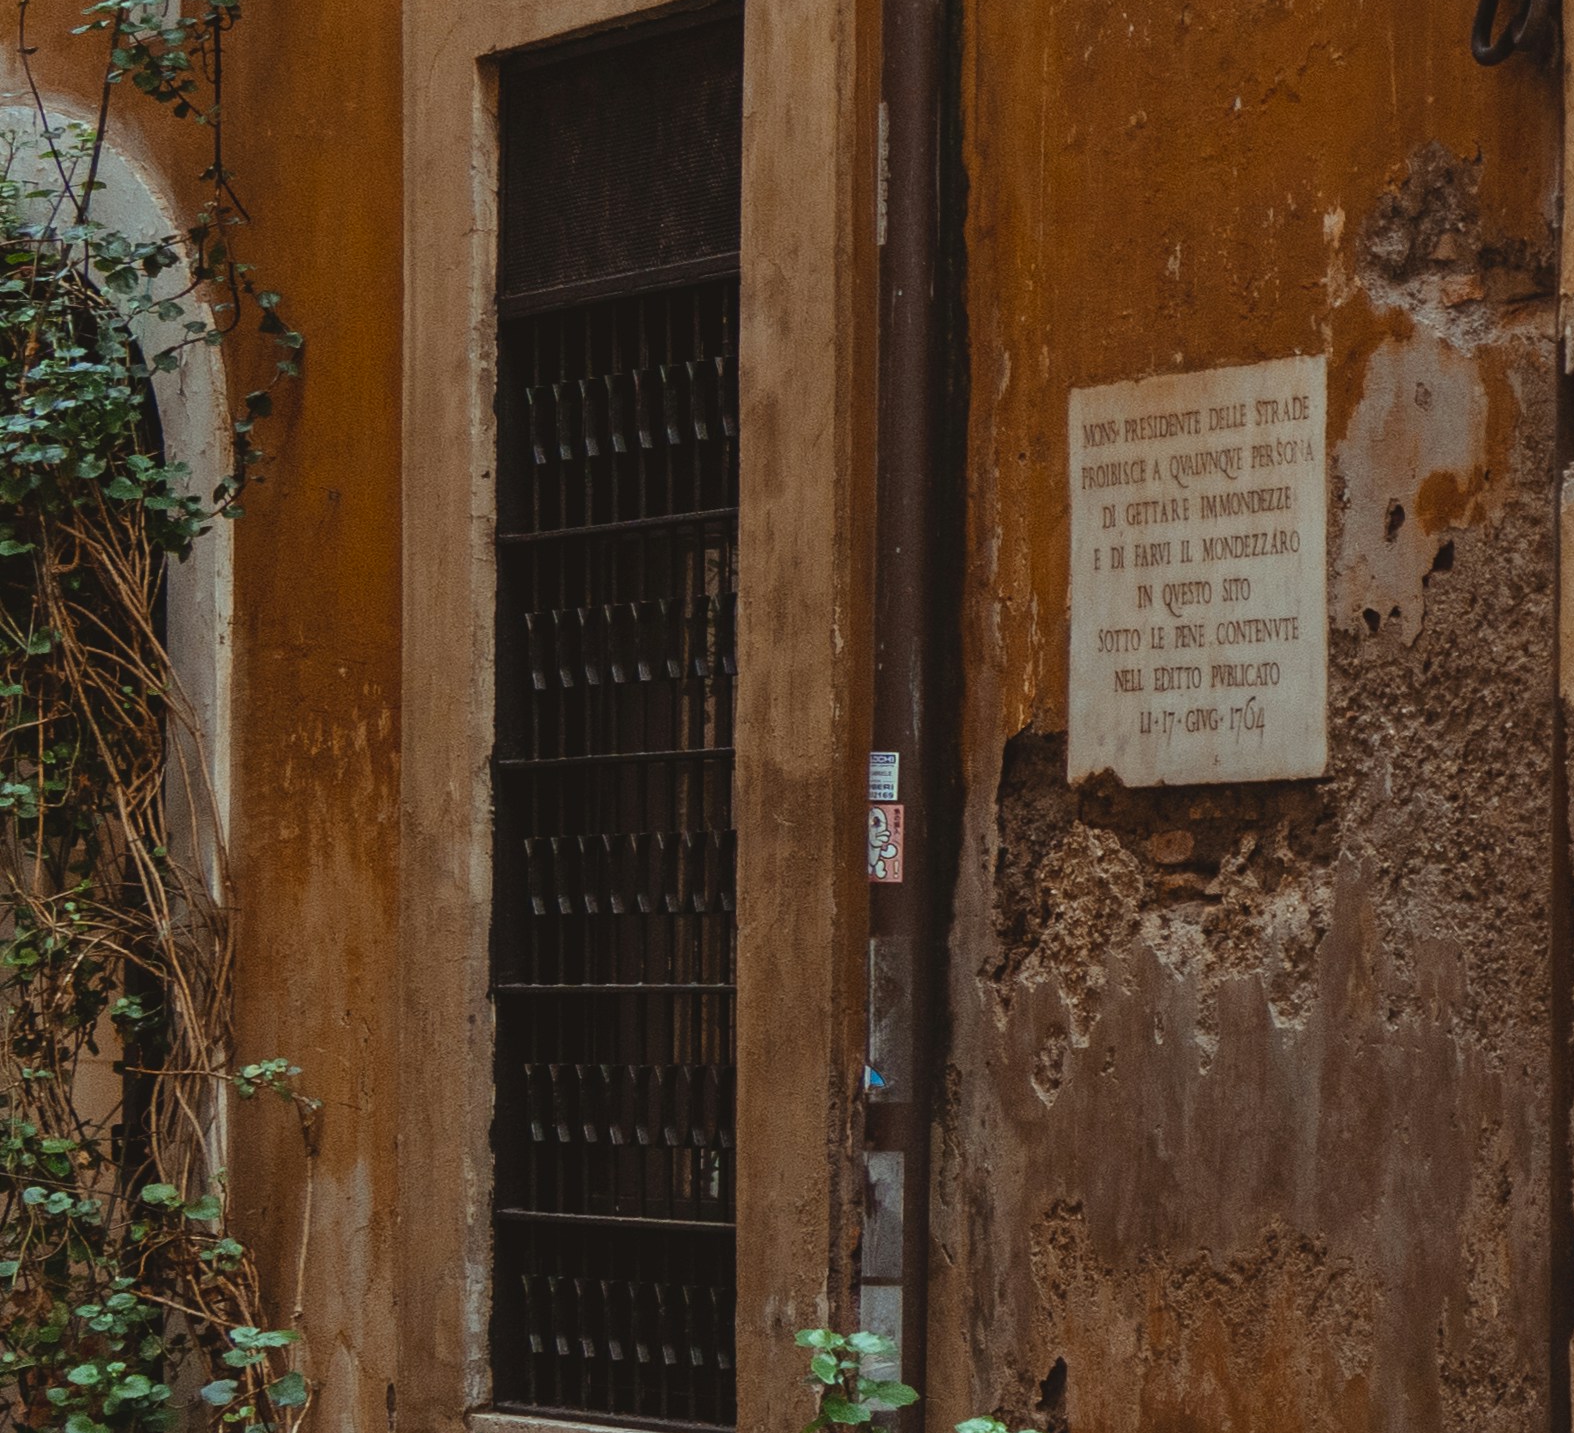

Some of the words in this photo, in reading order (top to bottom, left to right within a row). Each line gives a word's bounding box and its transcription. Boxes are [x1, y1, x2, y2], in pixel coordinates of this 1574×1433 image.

[1124, 411, 1201, 443] PRESIDENTE
[1208, 404, 1246, 431] DELLE
[1255, 396, 1309, 426] STRADE
[1081, 460, 1147, 490] PROIBISCE
[1152, 460, 1162, 481] A
[1169, 447, 1243, 488] QVALVNQVE
[1251, 438, 1314, 469] PERSONA
[1102, 504, 1116, 529] DI
[1125, 498, 1190, 526] GETTARE
[1200, 486, 1292, 519] IMMONDEZZE
[1093, 548, 1102, 570] E
[1110, 544, 1125, 569] DI
[1134, 541, 1172, 568] FARVI
[1180, 539, 1195, 565] IL
[1202, 529, 1301, 561] MONDEZZARO
[1137, 584, 1153, 609] IN
[1162, 580, 1212, 618] QVESTO
[1222, 578, 1251, 602] SITO
[1098, 629, 1141, 653] SOTTO
[1151, 627, 1165, 650] LE
[1174, 625, 1205, 649] PENE
[1216, 617, 1299, 645] CONTENVTE
[1114, 668, 1144, 693] NELL
[1153, 667, 1202, 692] EDITTO
[1210, 662, 1280, 689] PVBLICATO
[1229, 696, 1266, 745] 1764
